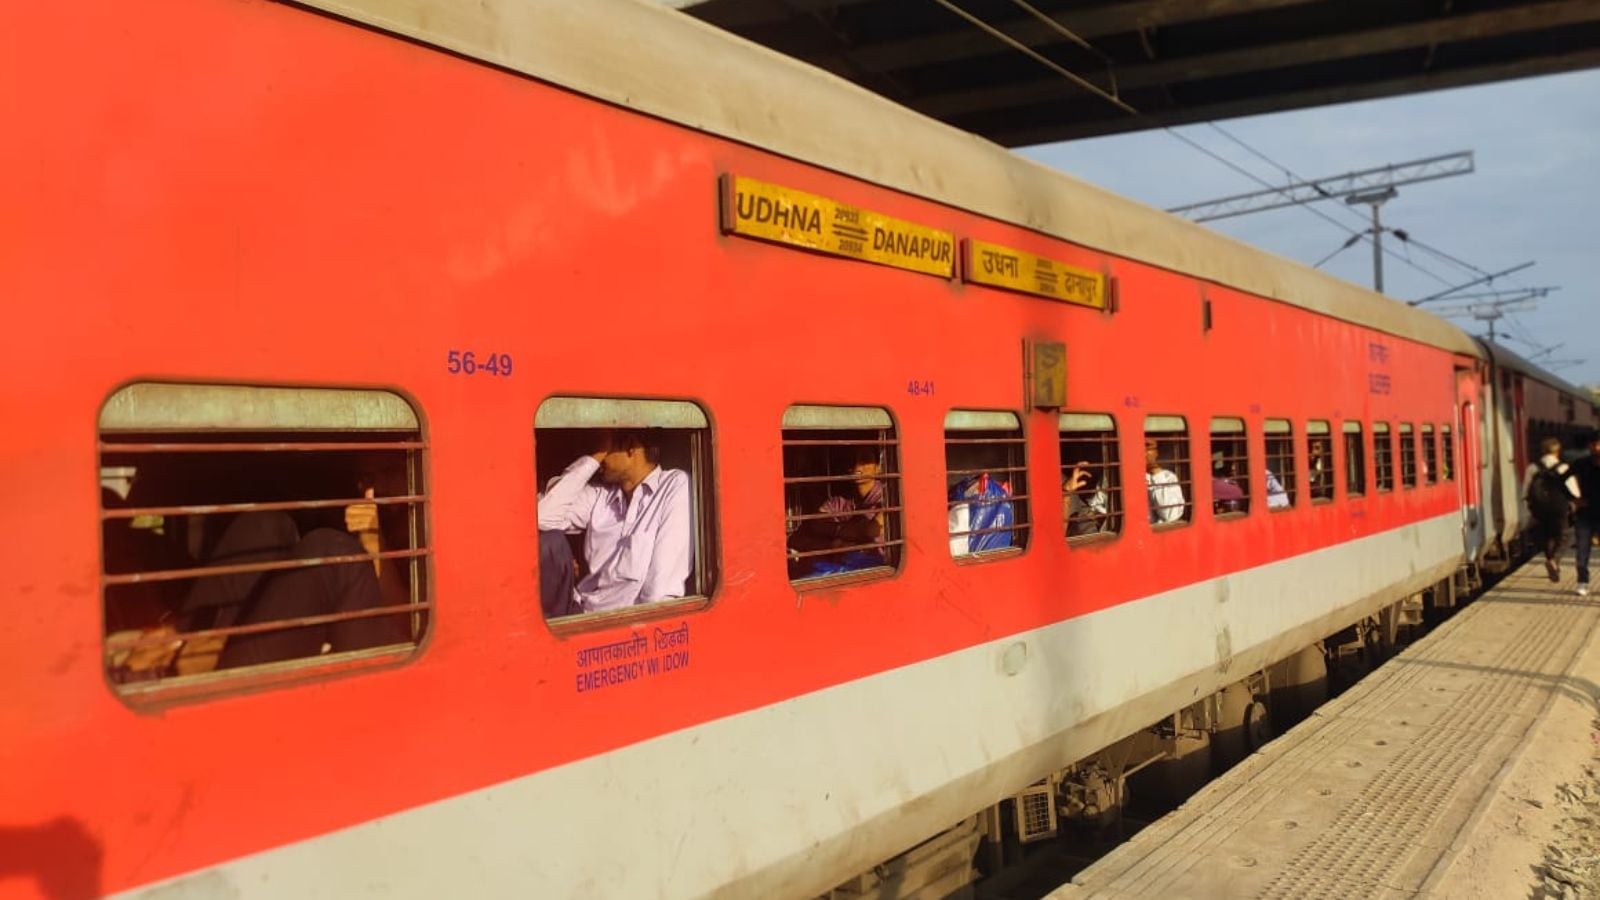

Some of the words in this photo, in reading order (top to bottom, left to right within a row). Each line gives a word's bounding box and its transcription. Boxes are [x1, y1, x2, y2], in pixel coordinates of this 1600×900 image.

[737, 192, 821, 234] UDHNA
[873, 227, 951, 263] DANAPUR
[982, 250, 1018, 278] उधना
[447, 350, 513, 376] 56-49
[907, 380, 935, 396] 48-41
[577, 632, 648, 667] आपातकालीन
[576, 661, 645, 693] EMERGENCY
